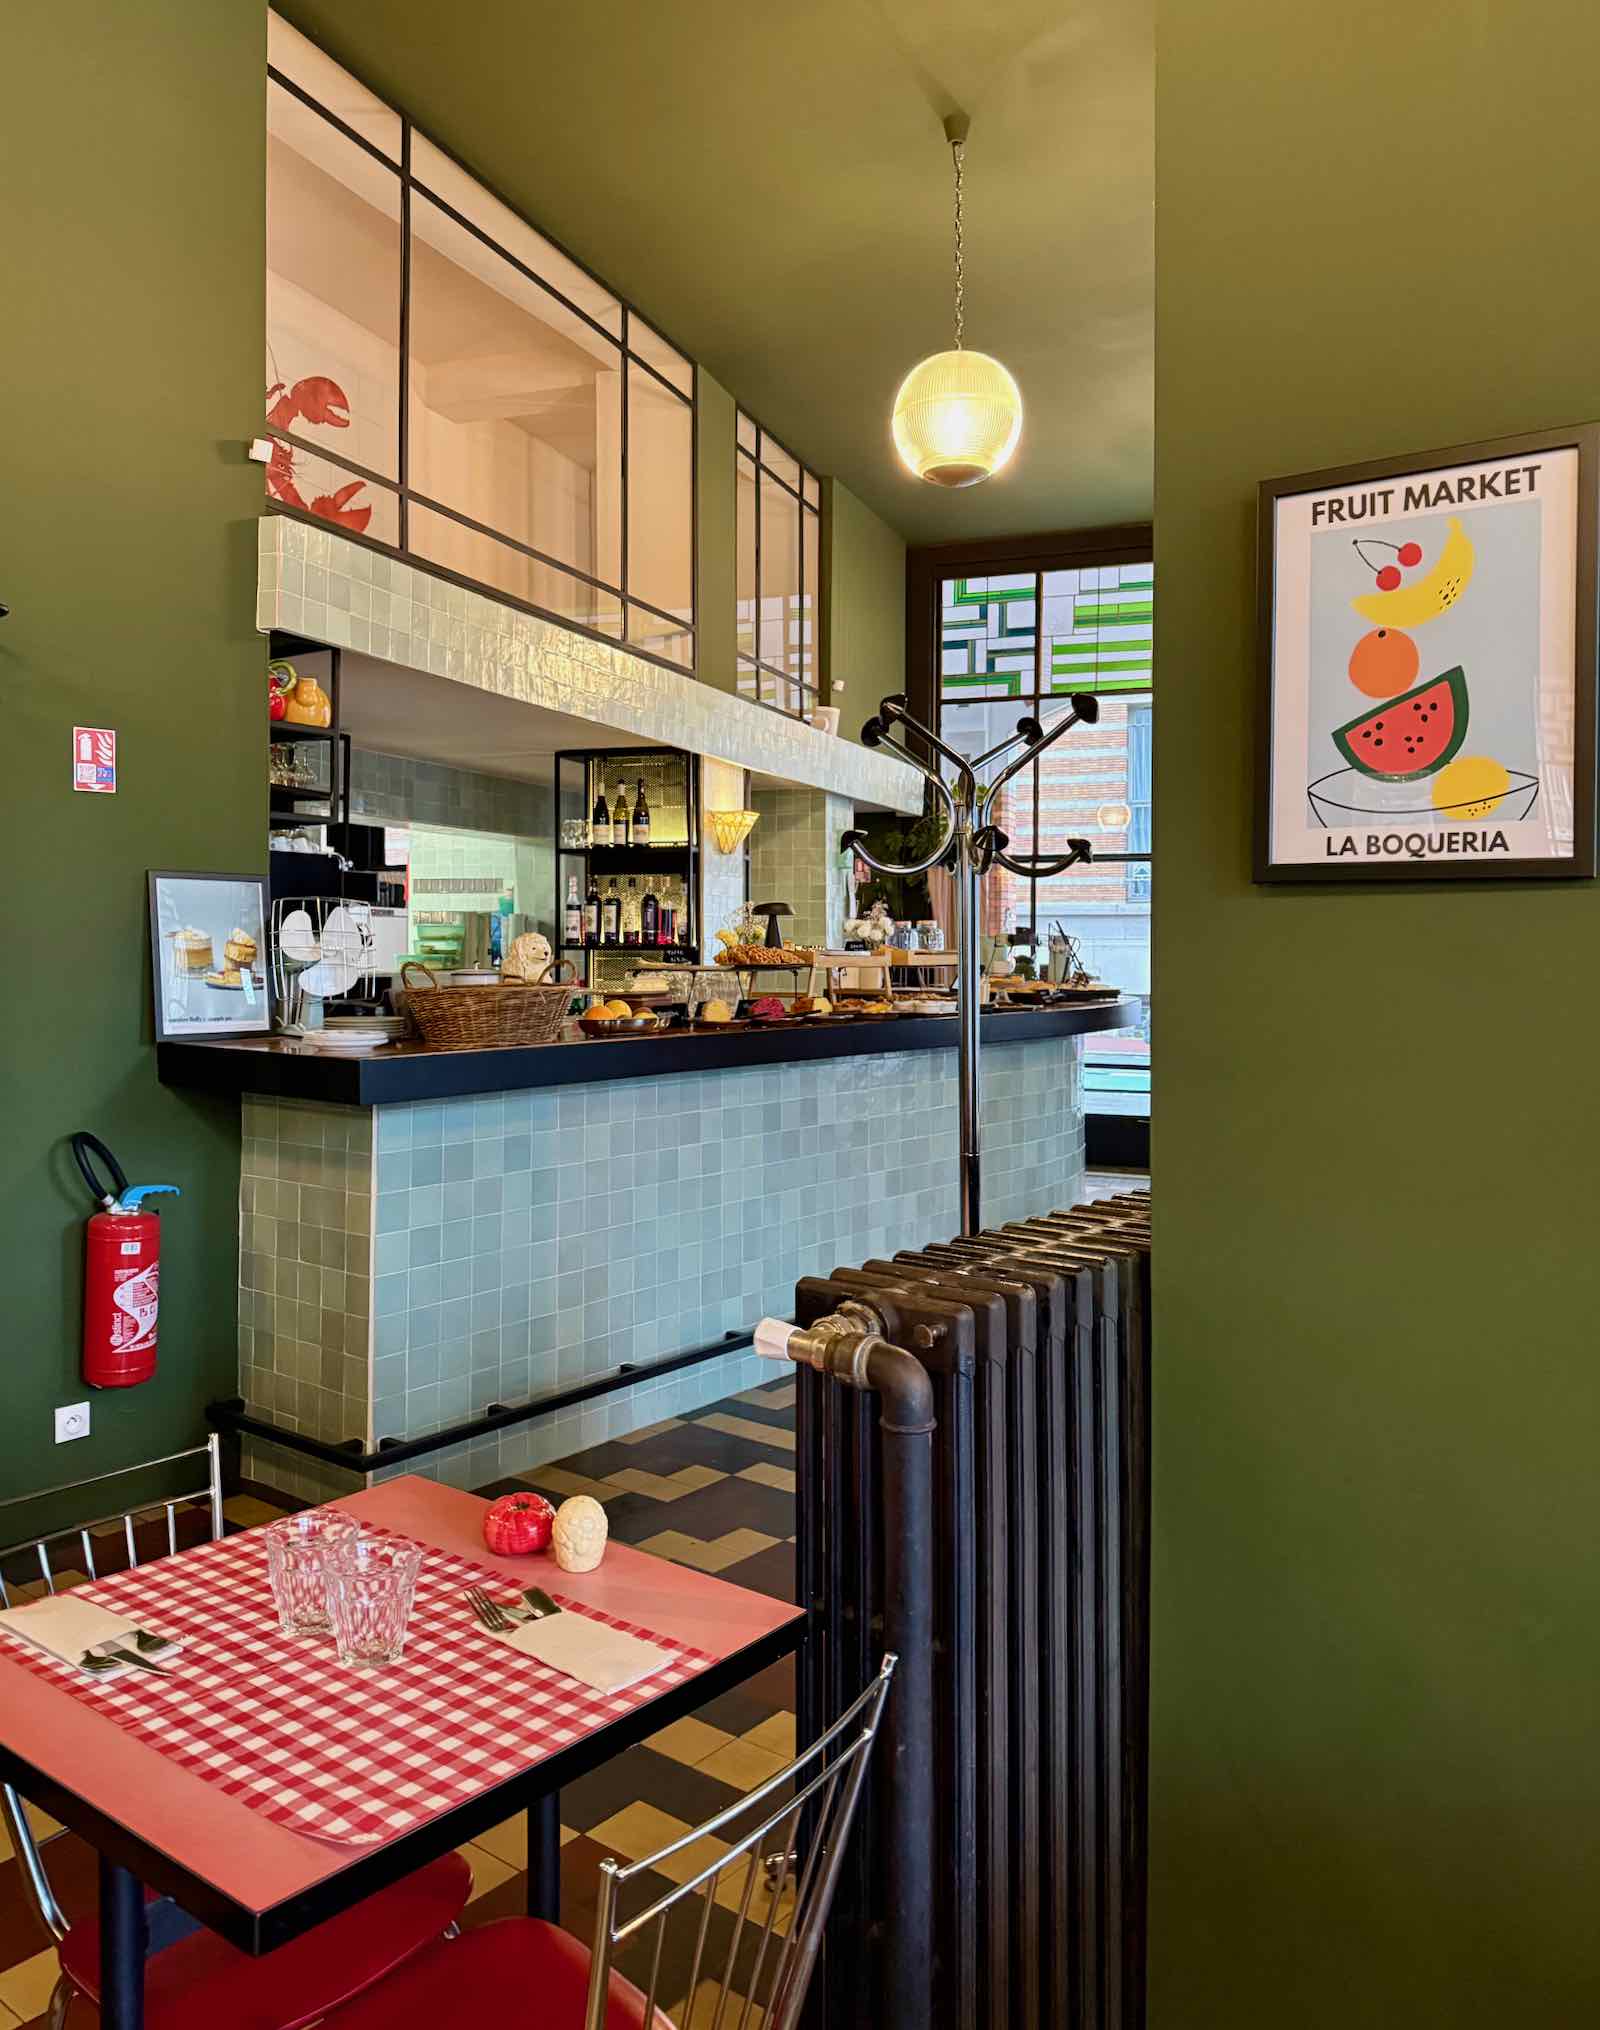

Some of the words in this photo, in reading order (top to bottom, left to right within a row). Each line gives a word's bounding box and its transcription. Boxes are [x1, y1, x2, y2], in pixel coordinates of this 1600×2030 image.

[1312, 490, 1394, 526] FRUIT
[1403, 465, 1542, 512] MARKET
[1326, 836, 1358, 856] LA
[1366, 830, 1510, 858] BOQUERIA
